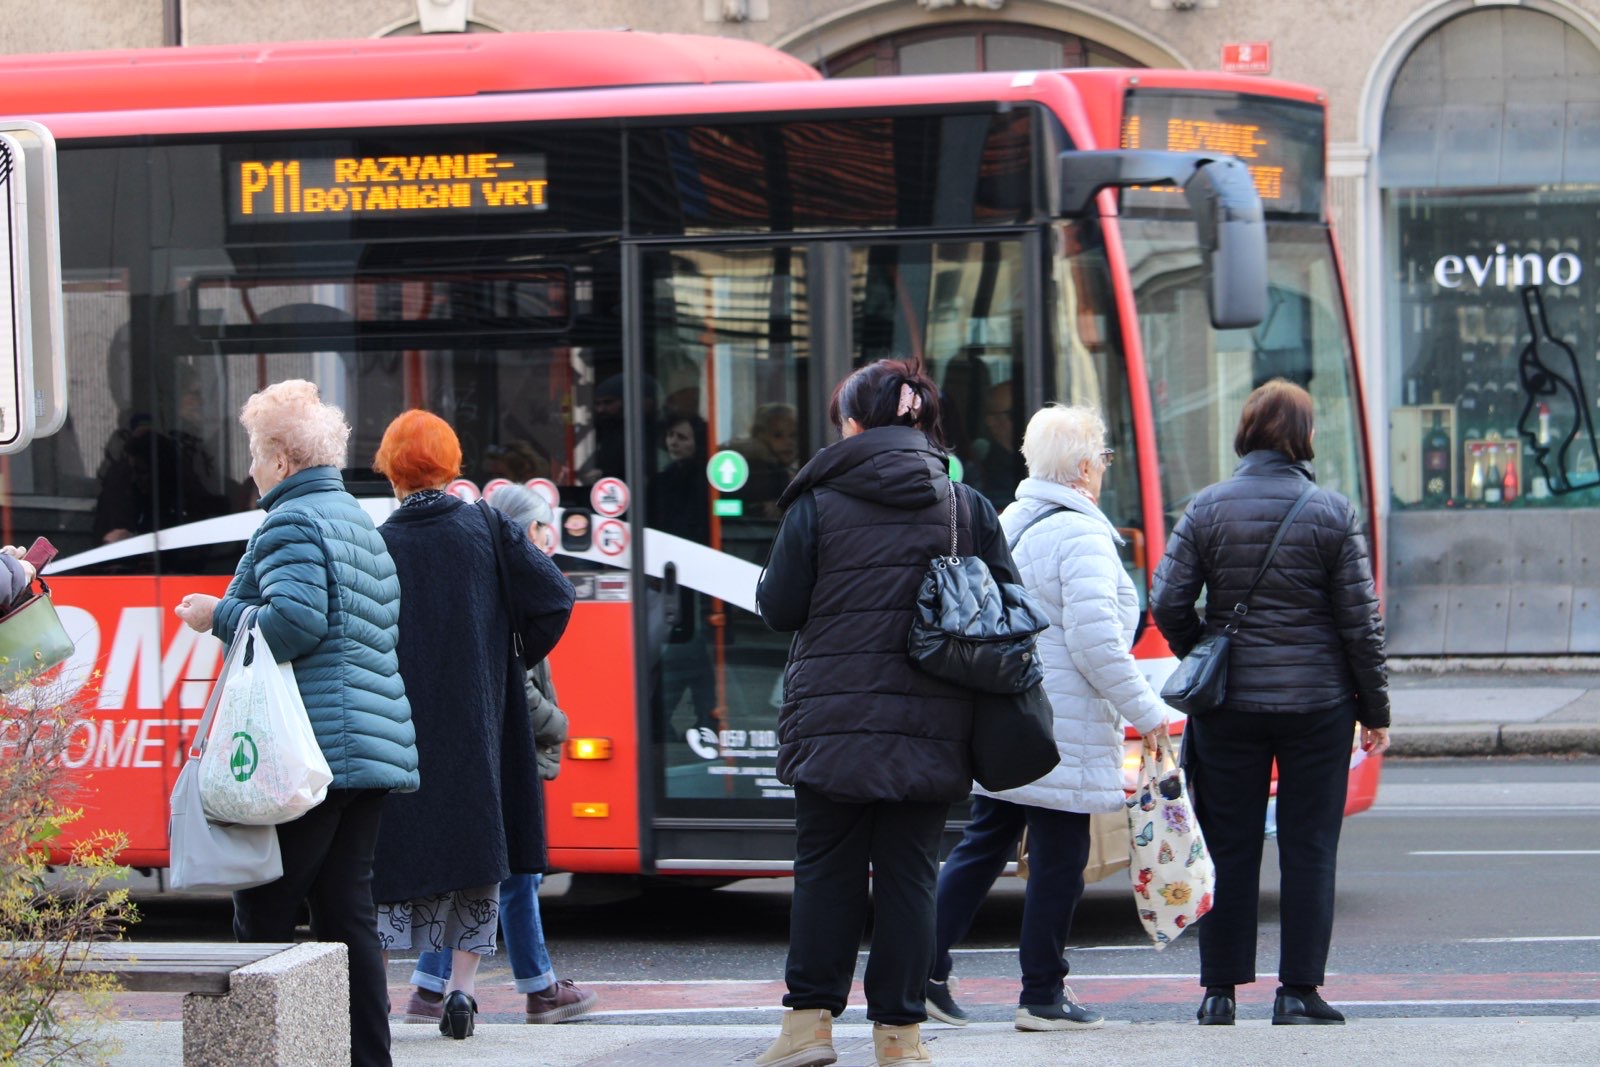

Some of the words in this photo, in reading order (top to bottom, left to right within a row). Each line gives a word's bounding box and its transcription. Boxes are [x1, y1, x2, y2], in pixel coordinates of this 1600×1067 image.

[240, 161, 300, 214] P11
[481, 180, 548, 206] VRT
[1433, 243, 1582, 288] evino
